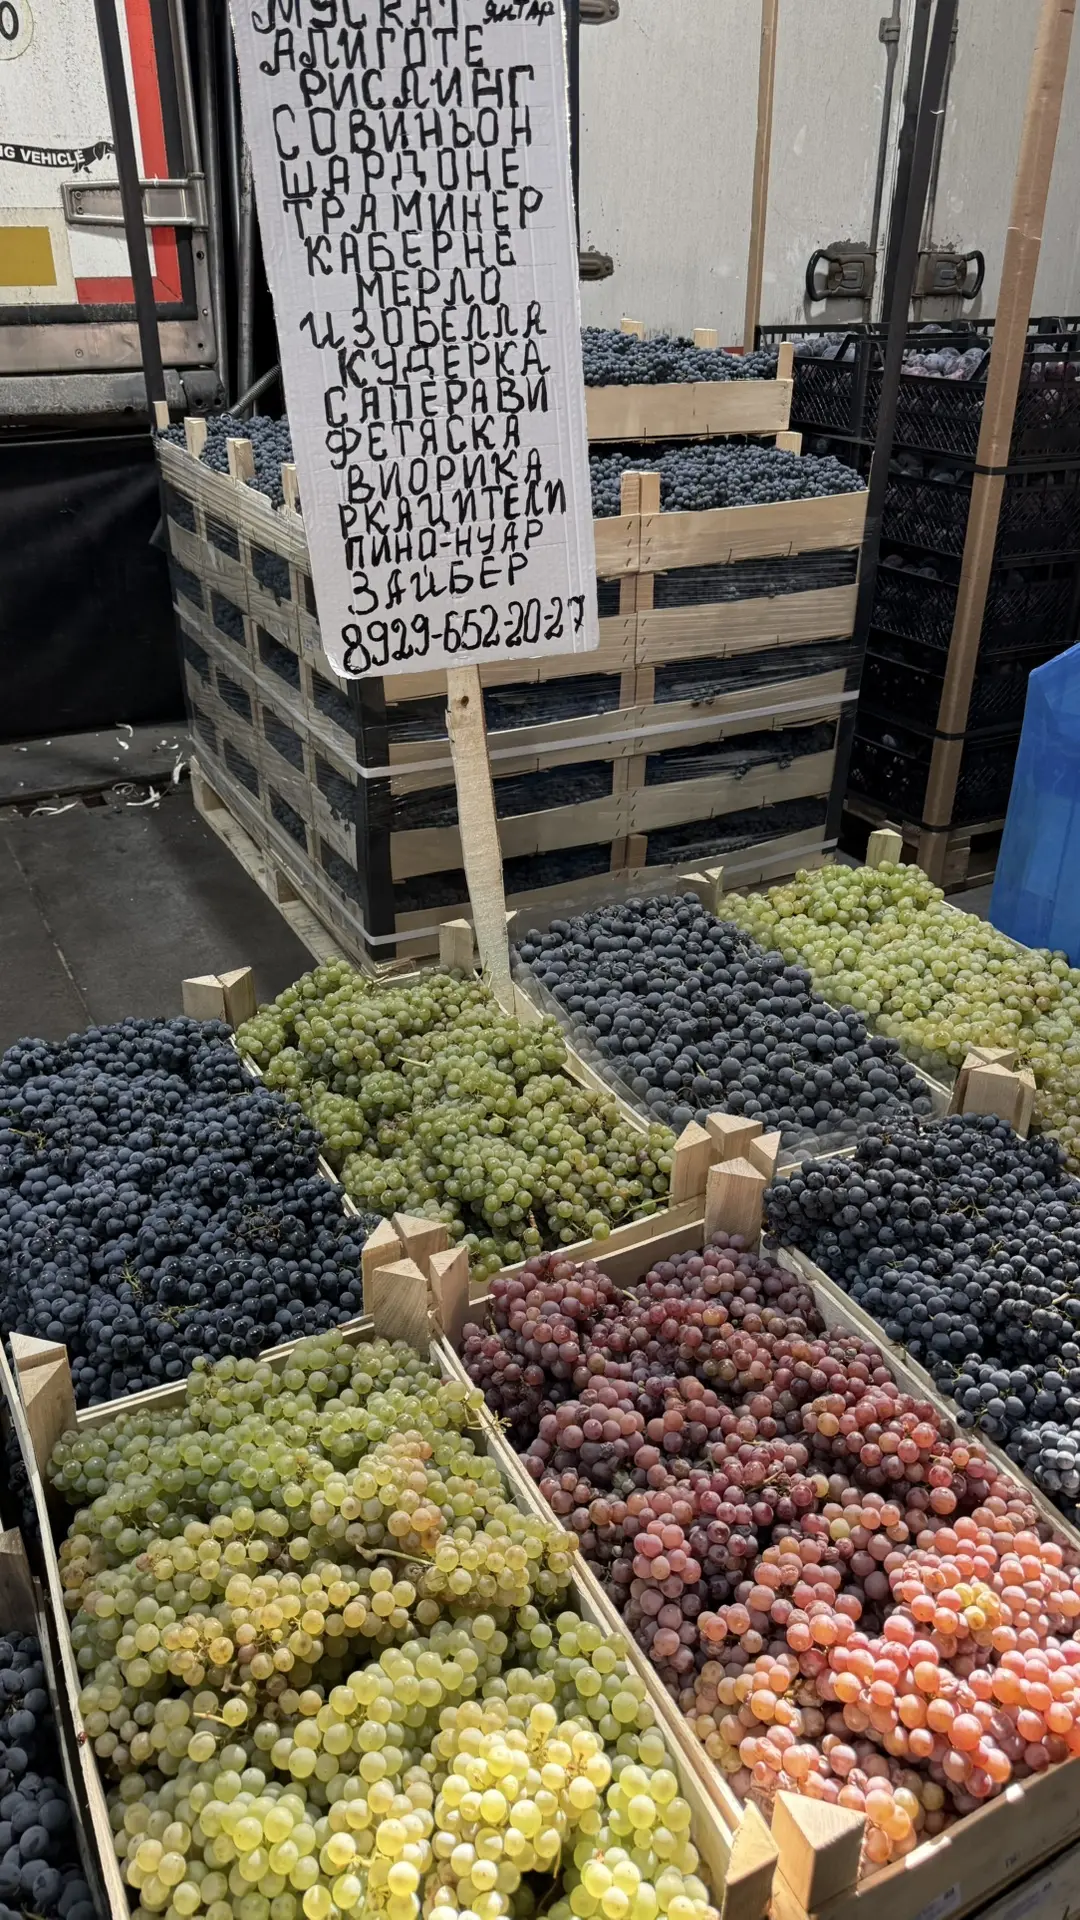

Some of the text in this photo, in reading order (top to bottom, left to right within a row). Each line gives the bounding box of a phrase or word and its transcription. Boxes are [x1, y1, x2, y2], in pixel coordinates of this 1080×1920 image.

[260, 25, 484, 76] АЛИГОТЕ
[300, 65, 534, 110] РИСЛИНГ
[0, 145, 86, 166] G VEHICLE
[273, 104, 532, 160] СОВИНЬОН
[280, 148, 520, 199] ШАРДОНЕ
[283, 186, 543, 240] ТРАМИНЕР
[304, 230, 516, 276] КАБЕРНЕ
[356, 265, 501, 309] МЕРЛО
[300, 301, 546, 348] ИЗОБЕЛЛА
[338, 339, 551, 387] КУДЕРКА
[324, 376, 548, 428] САПЕРАВИ
[325, 415, 520, 470] ФЕТЯСКА
[348, 448, 542, 504] ВИОРИКА
[339, 478, 567, 540] РКАЦИТЕЛИ
[345, 519, 543, 570] ПИНО-НУАР
[348, 552, 528, 615] ЗАЙБЕР
[341, 595, 585, 674] 8929-652-20-27
